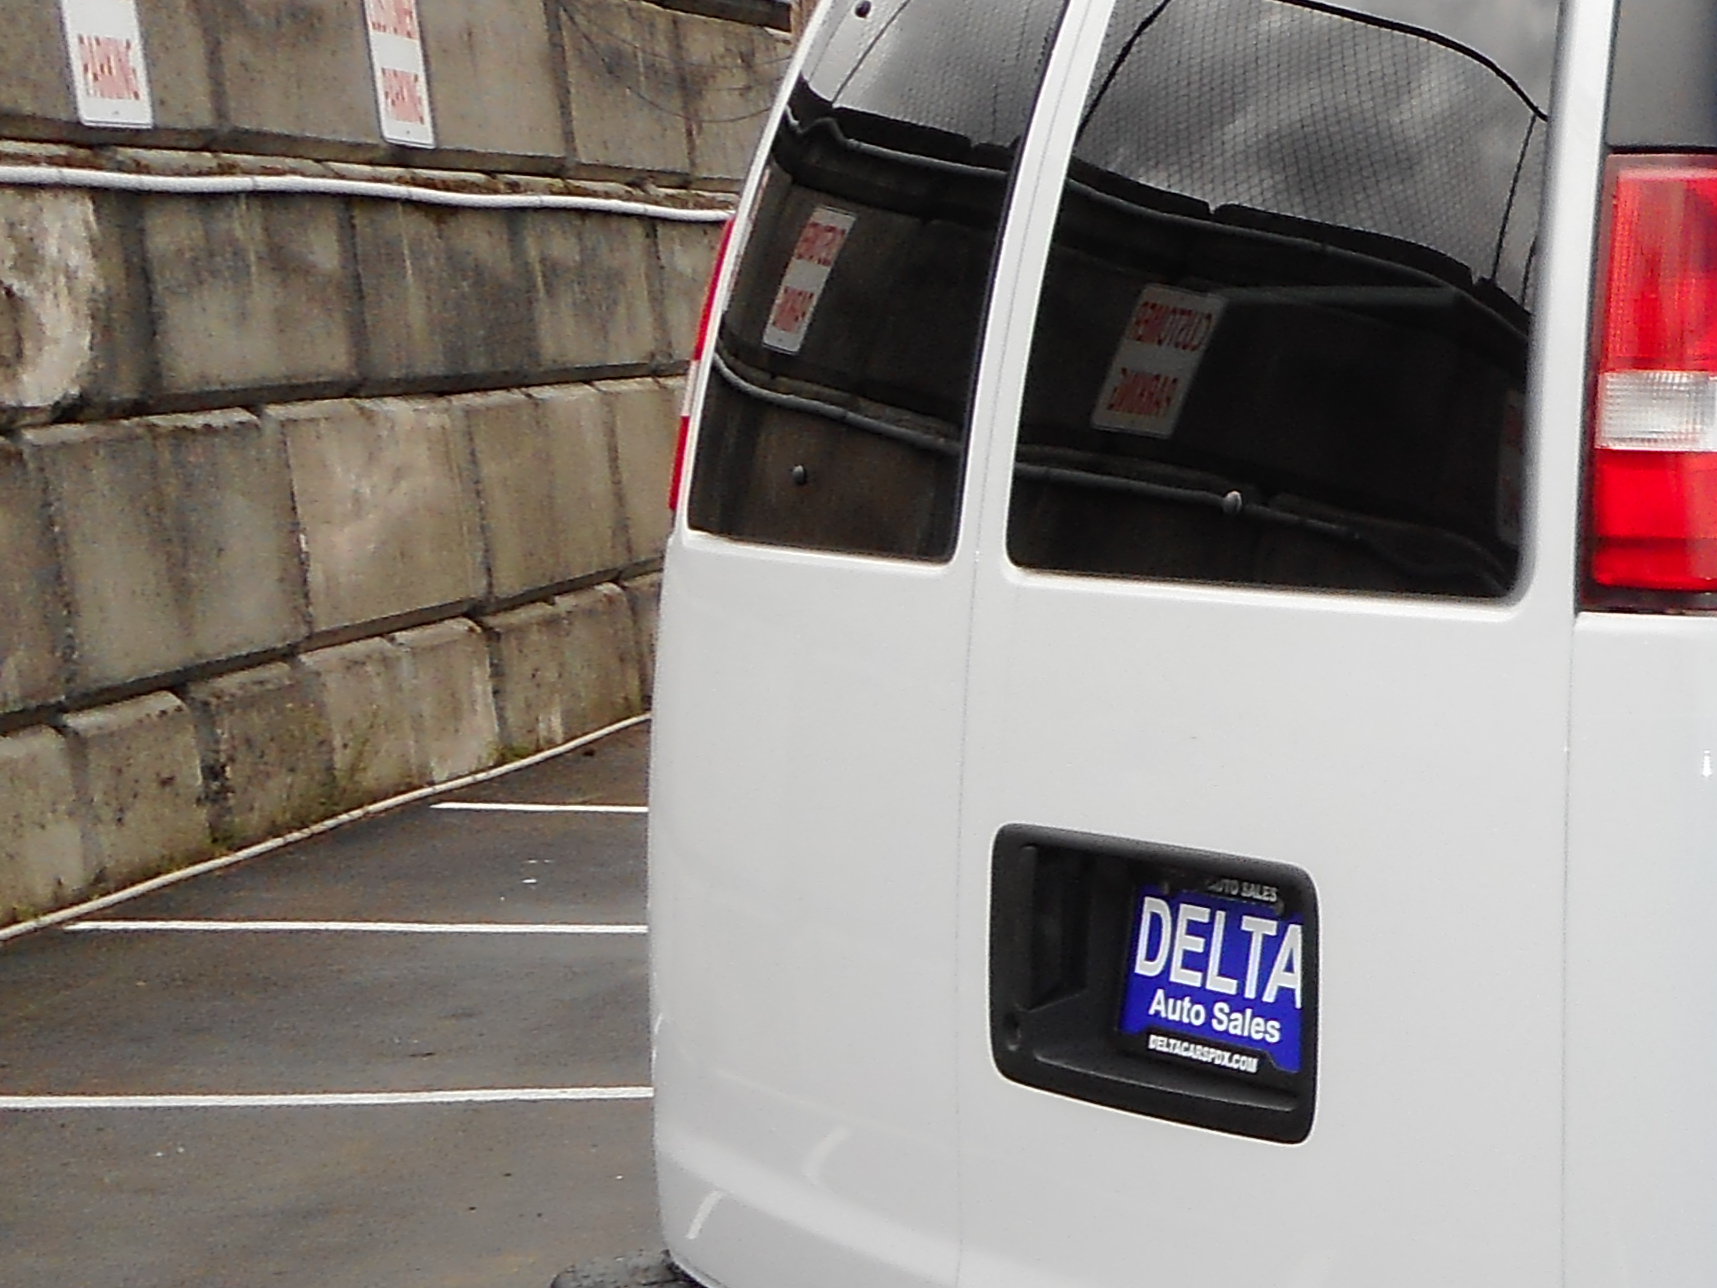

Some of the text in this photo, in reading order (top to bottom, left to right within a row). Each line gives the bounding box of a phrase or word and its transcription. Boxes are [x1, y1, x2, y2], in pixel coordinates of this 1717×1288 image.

[77, 33, 140, 100] PARKING
[1134, 895, 1303, 1009] DELTA
[1148, 988, 1282, 1044] Auto Sales
[1147, 1033, 1260, 1074] DELTACARSPDX.COM
